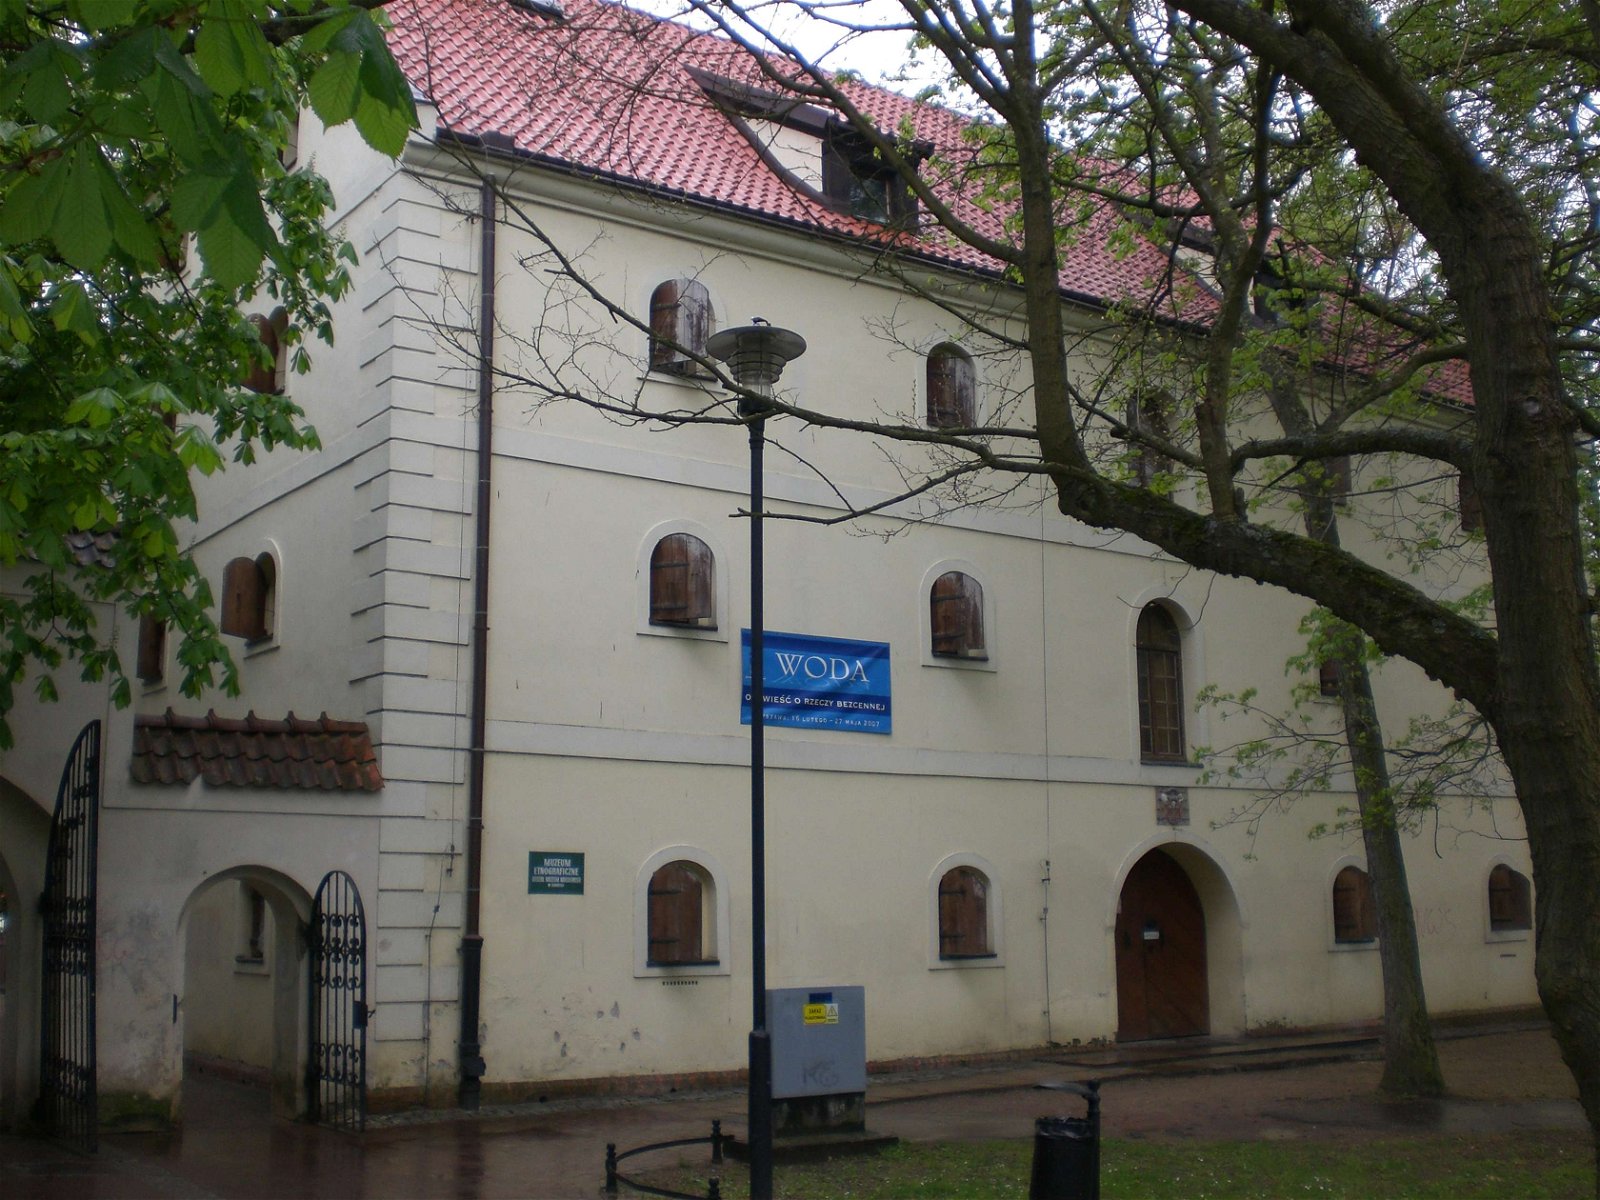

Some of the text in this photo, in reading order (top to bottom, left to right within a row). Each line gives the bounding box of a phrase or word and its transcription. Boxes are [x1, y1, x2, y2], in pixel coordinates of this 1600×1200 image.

[775, 652, 870, 683] WODA
[745, 693, 886, 711] OWIEŚĆ O RZECZY BEZCENNEJ
[802, 716, 828, 724] LUTEGO
[543, 858, 571, 868] MUZEUM
[533, 867, 579, 876] ETNOGRAFICZNE
